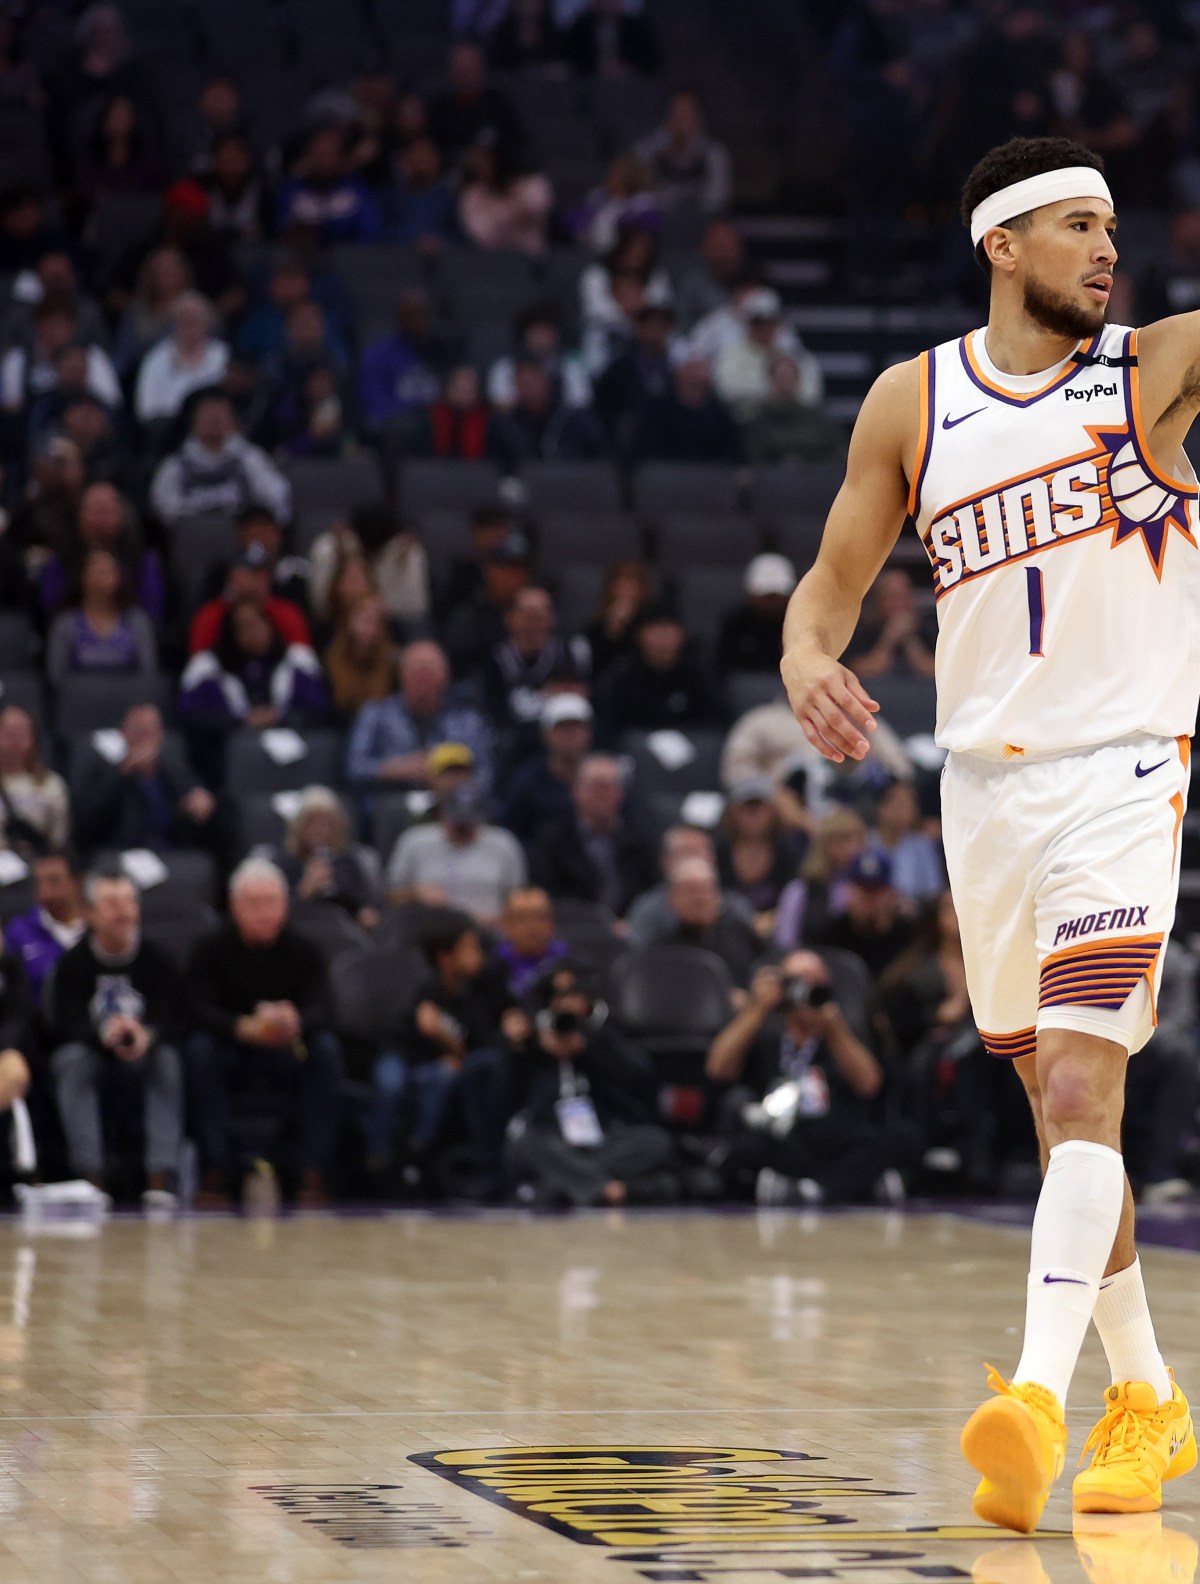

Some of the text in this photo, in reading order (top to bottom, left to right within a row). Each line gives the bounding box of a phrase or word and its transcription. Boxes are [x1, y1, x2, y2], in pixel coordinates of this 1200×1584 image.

[1065, 383, 1118, 402] PayPal
[930, 459, 1102, 589] SUNS
[1024, 566, 1045, 658] 1
[1053, 905, 1149, 946] PHOENIX
